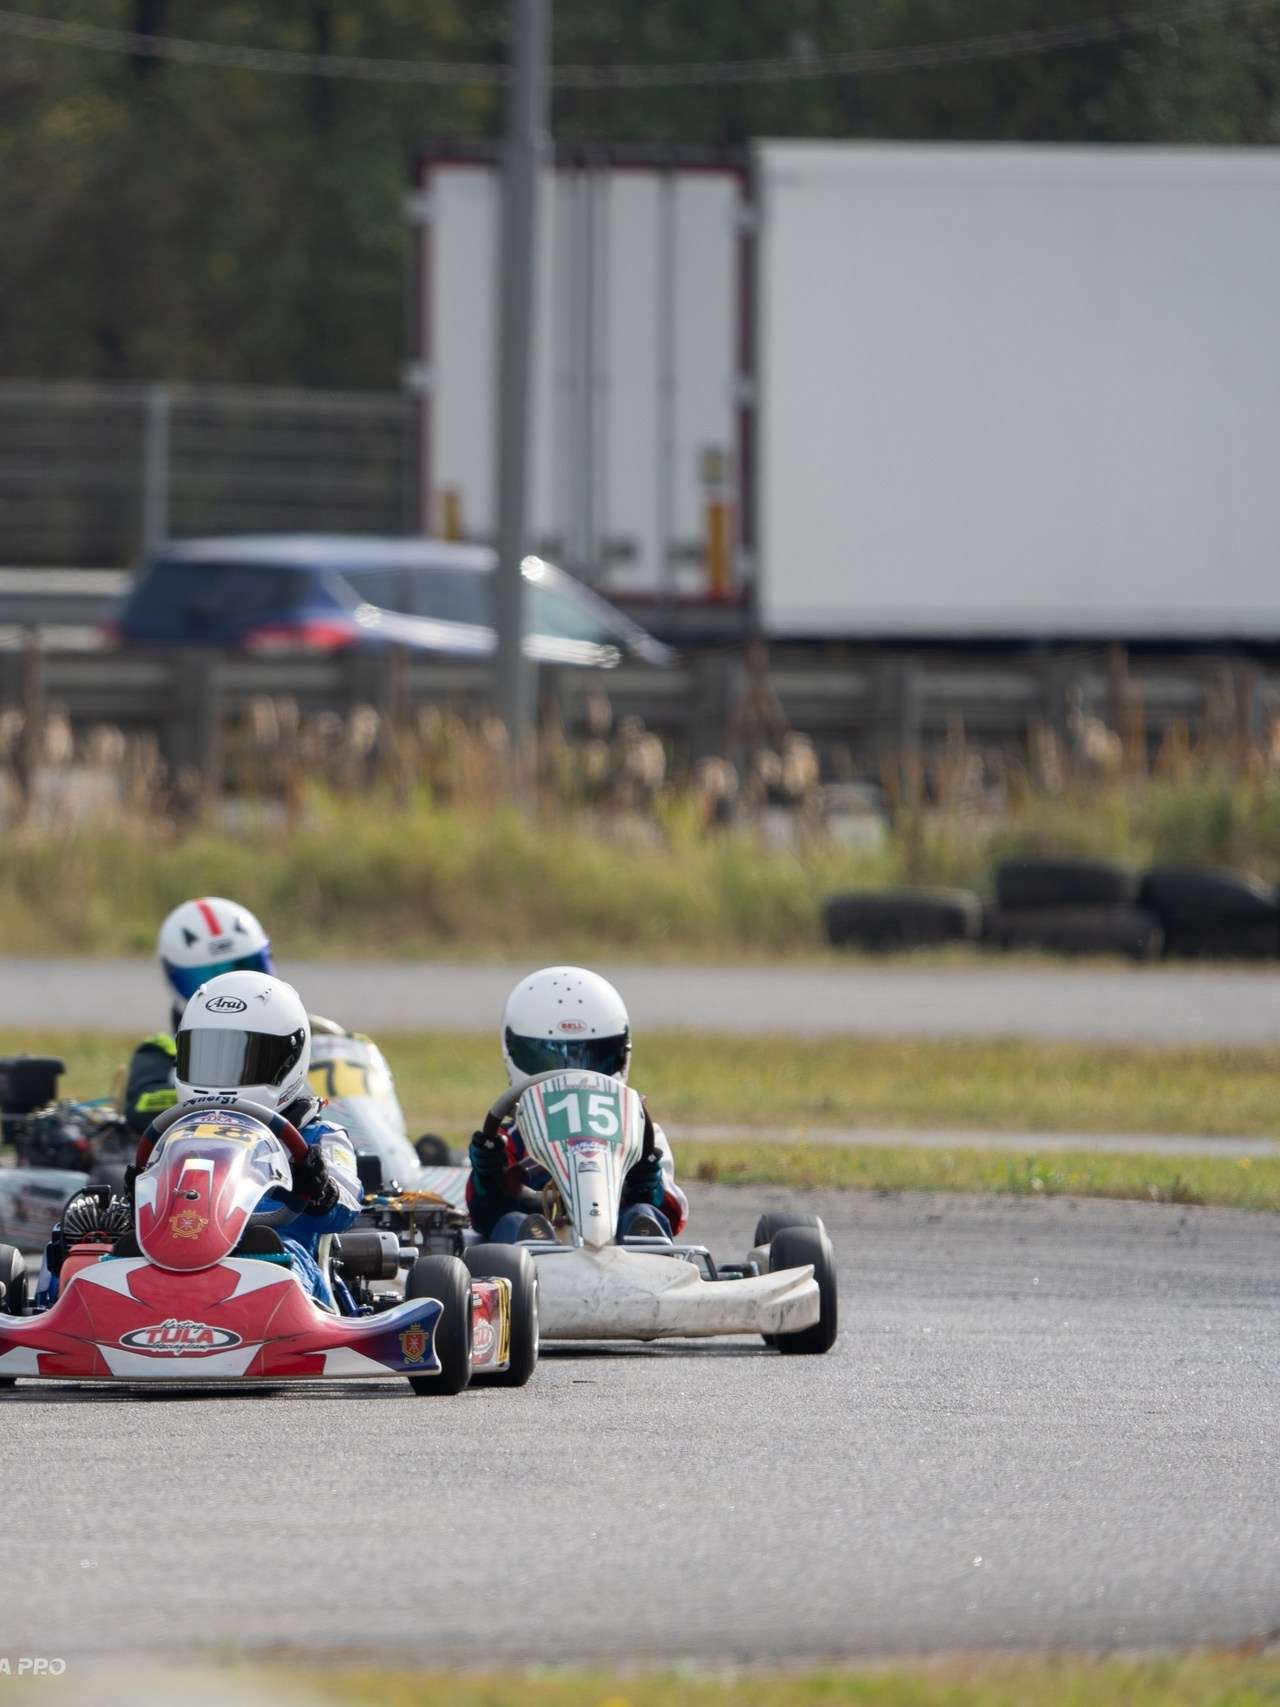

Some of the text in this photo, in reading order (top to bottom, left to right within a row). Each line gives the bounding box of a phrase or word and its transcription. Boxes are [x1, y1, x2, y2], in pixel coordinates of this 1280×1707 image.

[208, 997, 243, 1010] Arai
[561, 1022, 584, 1031] BELL
[548, 1093, 619, 1136] 15
[161, 1320, 205, 1333] Karting
[145, 1329, 214, 1344] TULA
